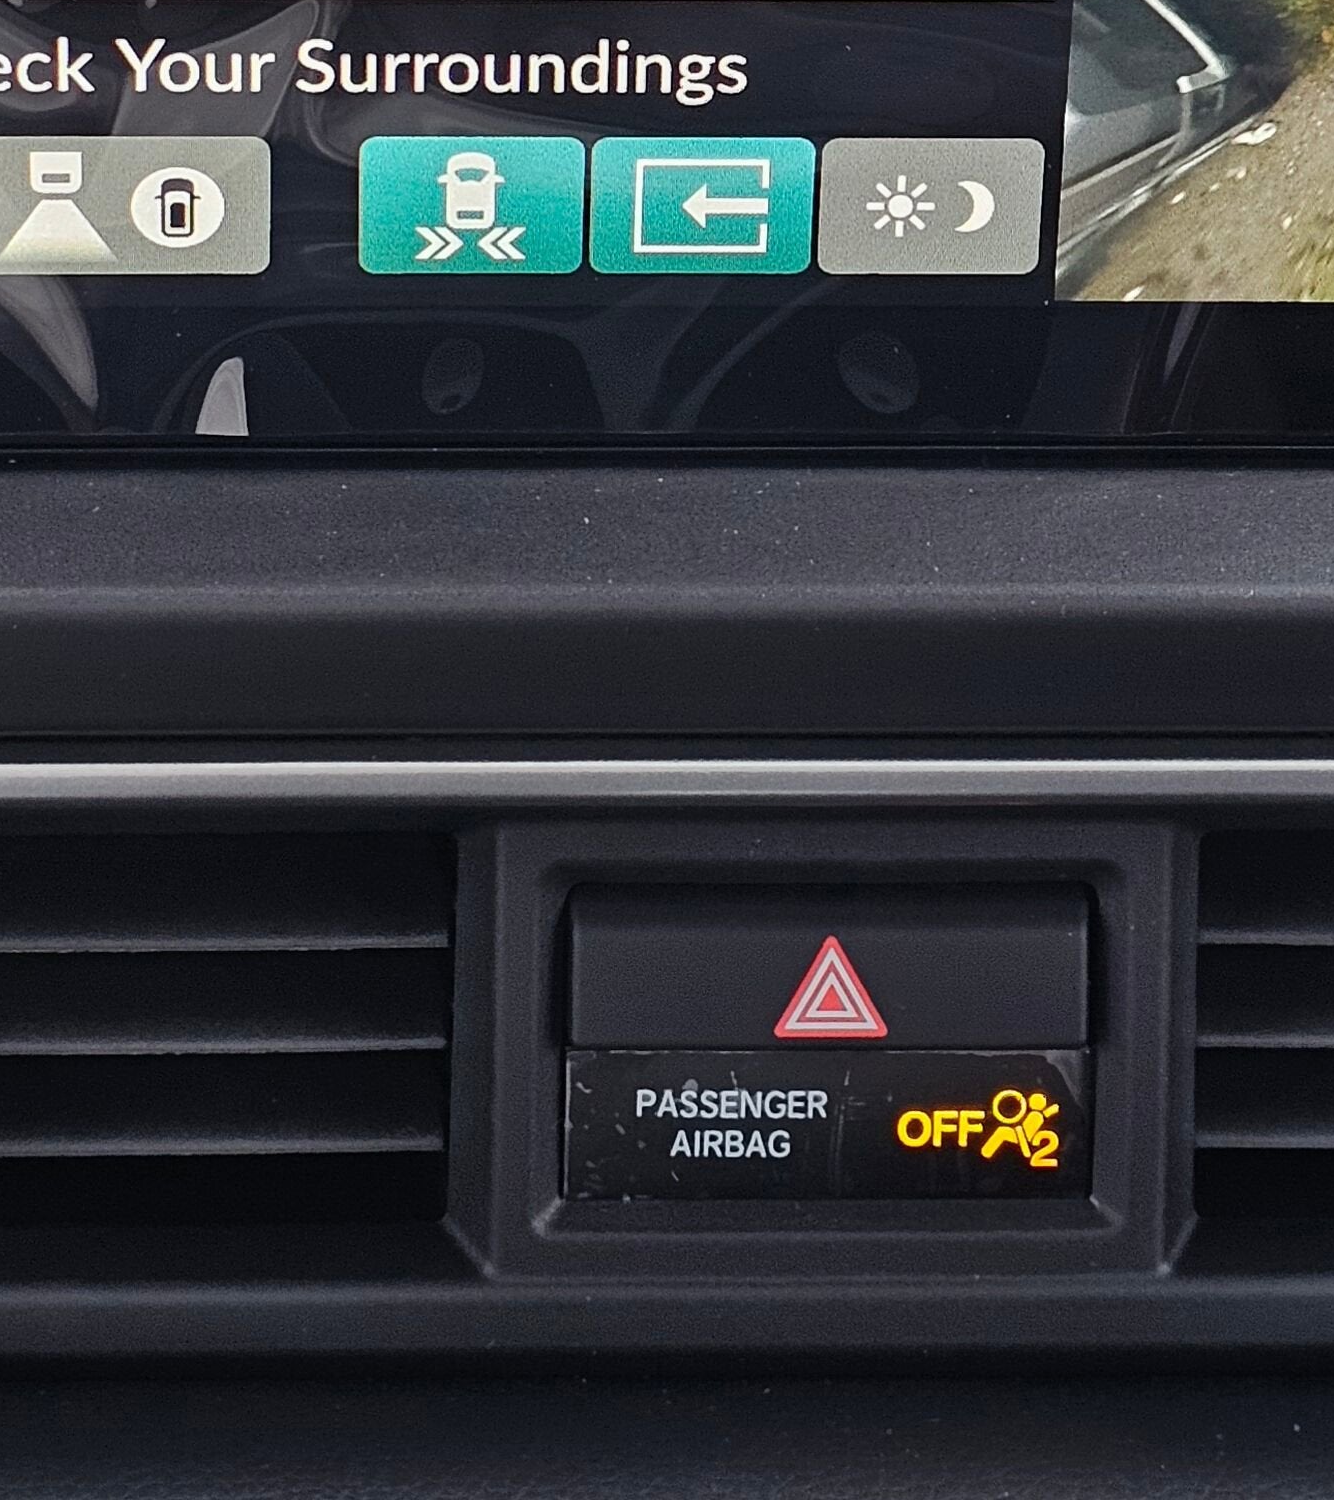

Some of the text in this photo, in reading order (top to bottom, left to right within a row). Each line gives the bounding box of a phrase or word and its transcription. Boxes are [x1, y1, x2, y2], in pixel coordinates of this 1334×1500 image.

[116, 38, 276, 93] Your
[295, 38, 748, 106] Surroundings
[635, 1088, 828, 1120] PASSENGER
[670, 1129, 792, 1158] AIRBAG
[896, 1109, 985, 1148] OFF
